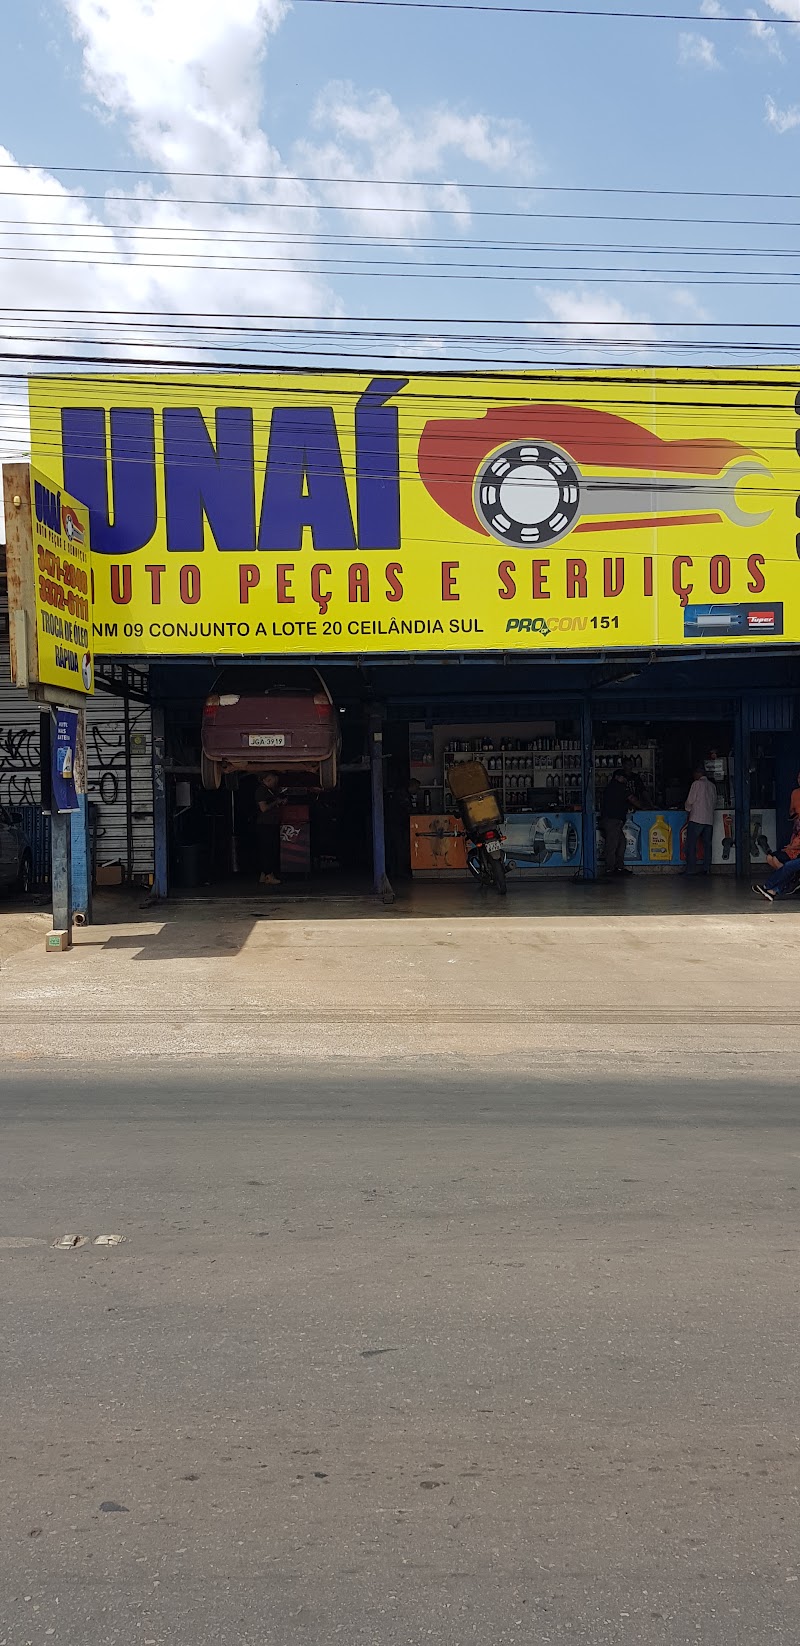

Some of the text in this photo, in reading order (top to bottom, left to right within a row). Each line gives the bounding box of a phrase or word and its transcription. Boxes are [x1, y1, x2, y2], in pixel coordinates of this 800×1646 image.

[61, 378, 409, 554] UNAÍ
[91, 553, 766, 615] UTO PEÇAS E SERVIÇOS
[41, 609, 89, 649] TROCA DE ÓLEO
[123, 623, 144, 637] 09
[149, 622, 250, 637] CONJUNTO
[255, 622, 267, 636] A
[272, 621, 317, 636] LOTE
[322, 621, 342, 635] 20
[347, 617, 444, 635] CEILÂNDIA
[449, 618, 484, 633] SUL
[505, 615, 620, 633] PROCON 151
[55, 643, 79, 673] RÁPIDA
